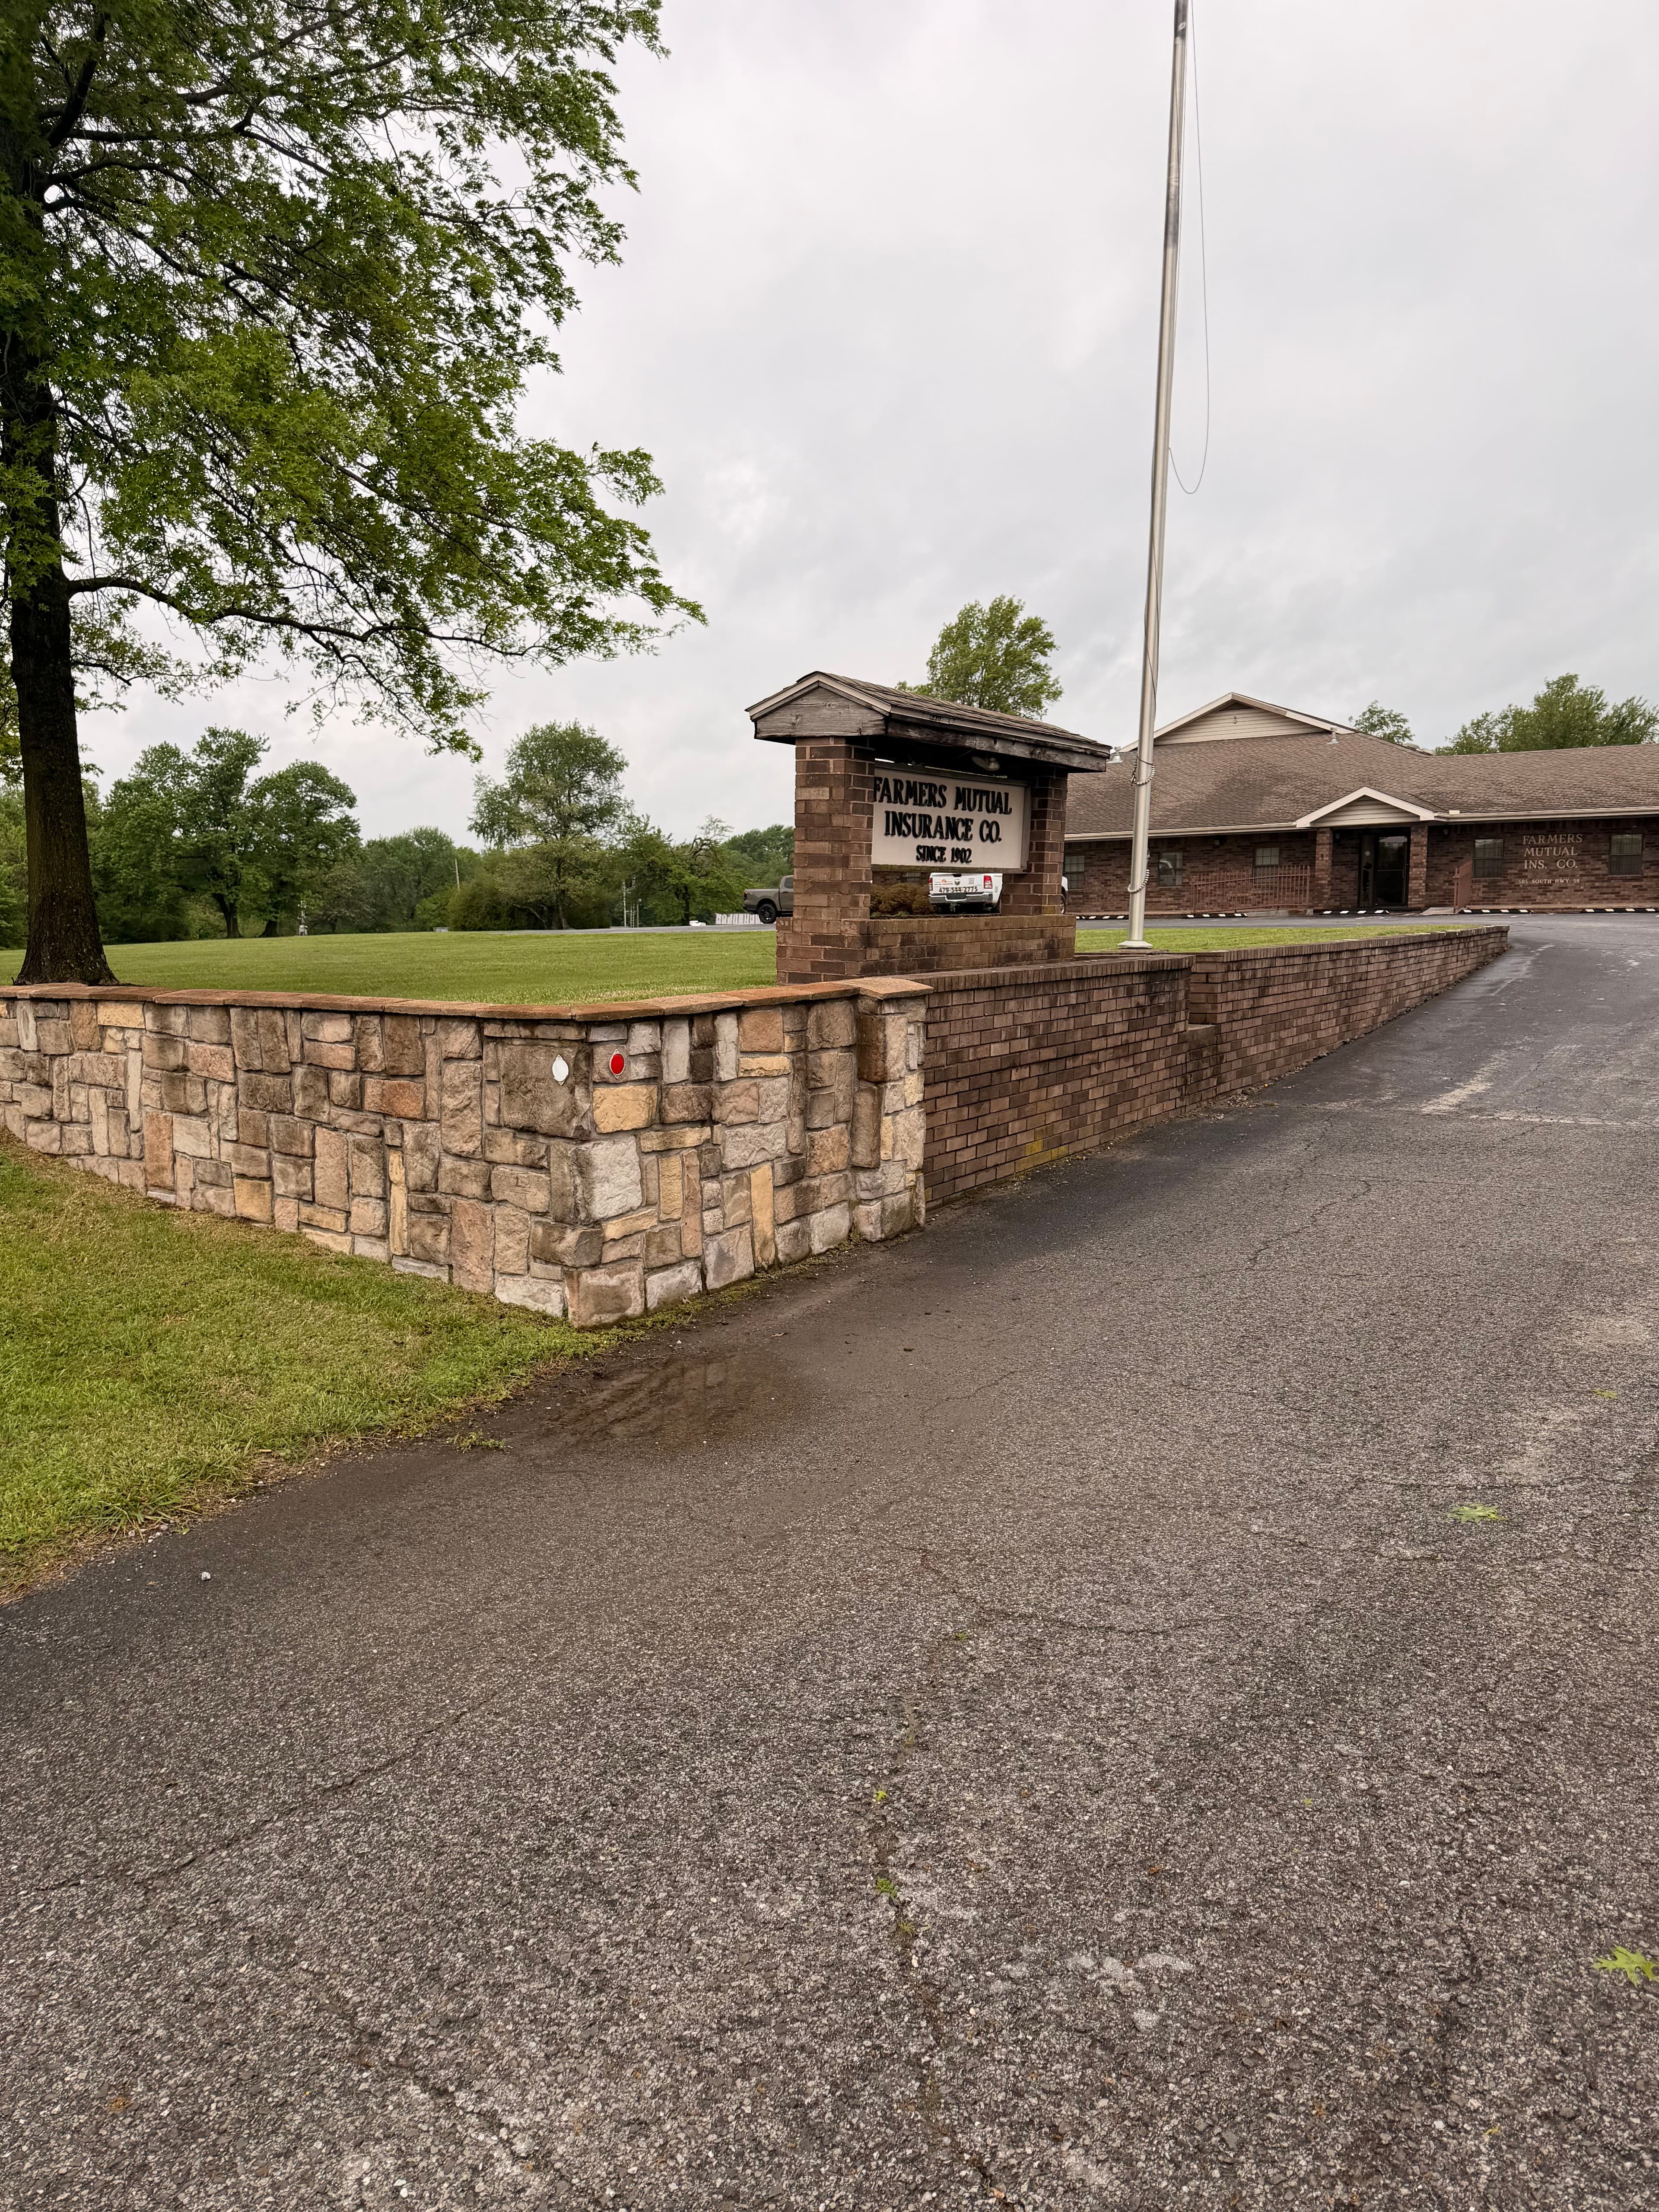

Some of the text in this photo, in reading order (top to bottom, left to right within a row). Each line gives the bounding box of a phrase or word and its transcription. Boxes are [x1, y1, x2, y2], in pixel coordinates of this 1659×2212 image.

[874, 776, 1012, 815] FARMERS MUTUAL
[884, 810, 1002, 843] INSURANCE CO.
[1522, 833, 1583, 845] FARMERS
[916, 845, 972, 864] SINCE 1902
[1524, 846, 1578, 857] MUTUAL
[1524, 859, 1577, 869] INS. CO.
